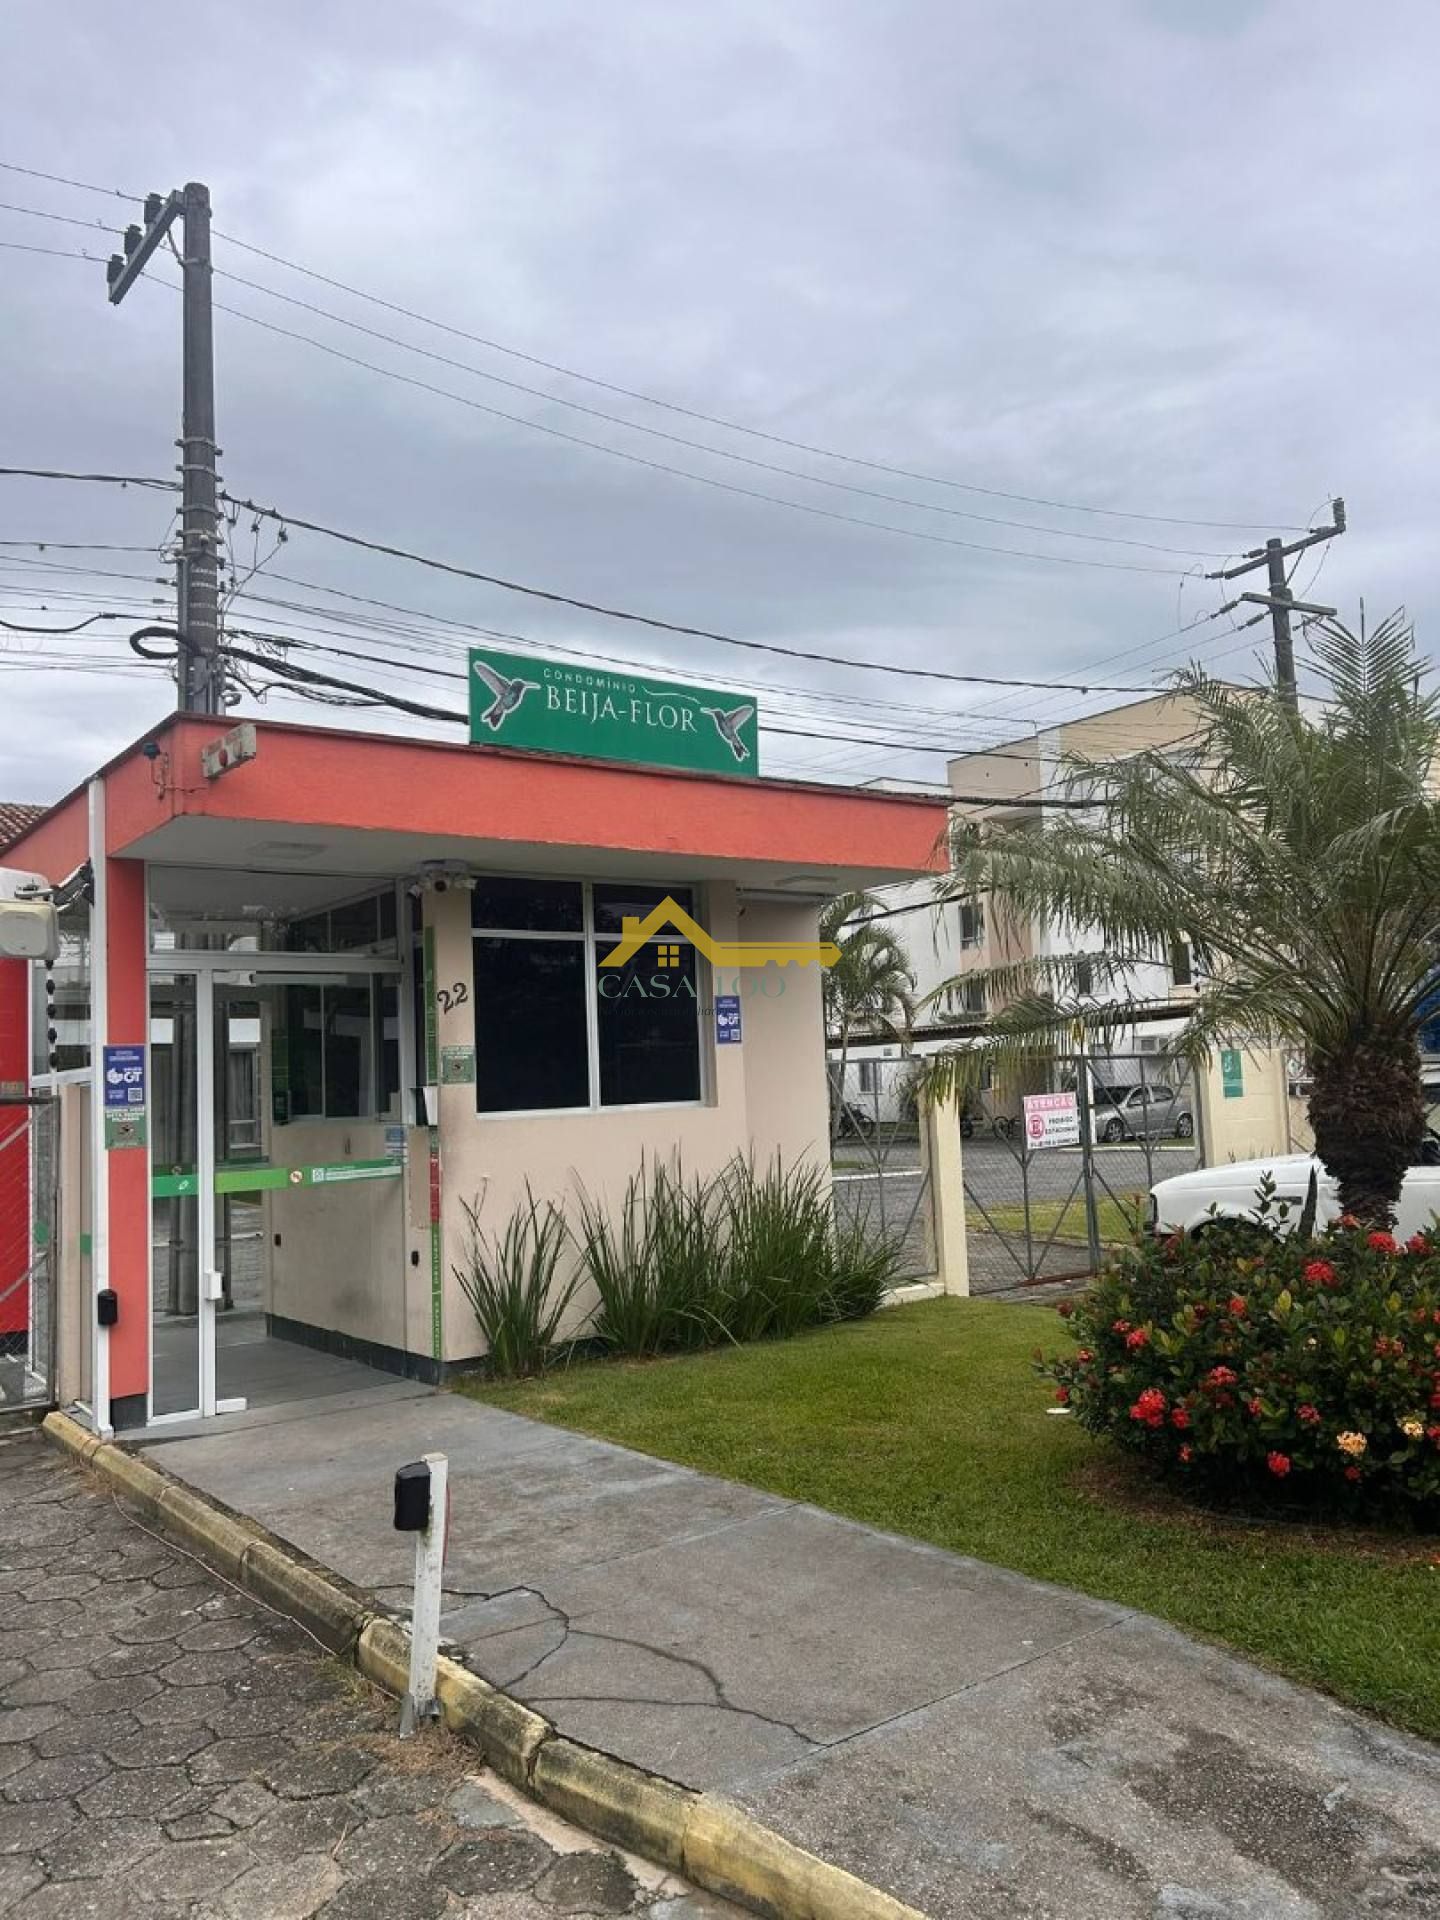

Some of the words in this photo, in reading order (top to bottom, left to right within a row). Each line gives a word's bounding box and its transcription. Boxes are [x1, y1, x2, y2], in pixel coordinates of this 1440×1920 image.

[546, 685, 698, 733] BEIJA-FLOR
[437, 982, 468, 1014] 22
[123, 1071, 143, 1084] GT
